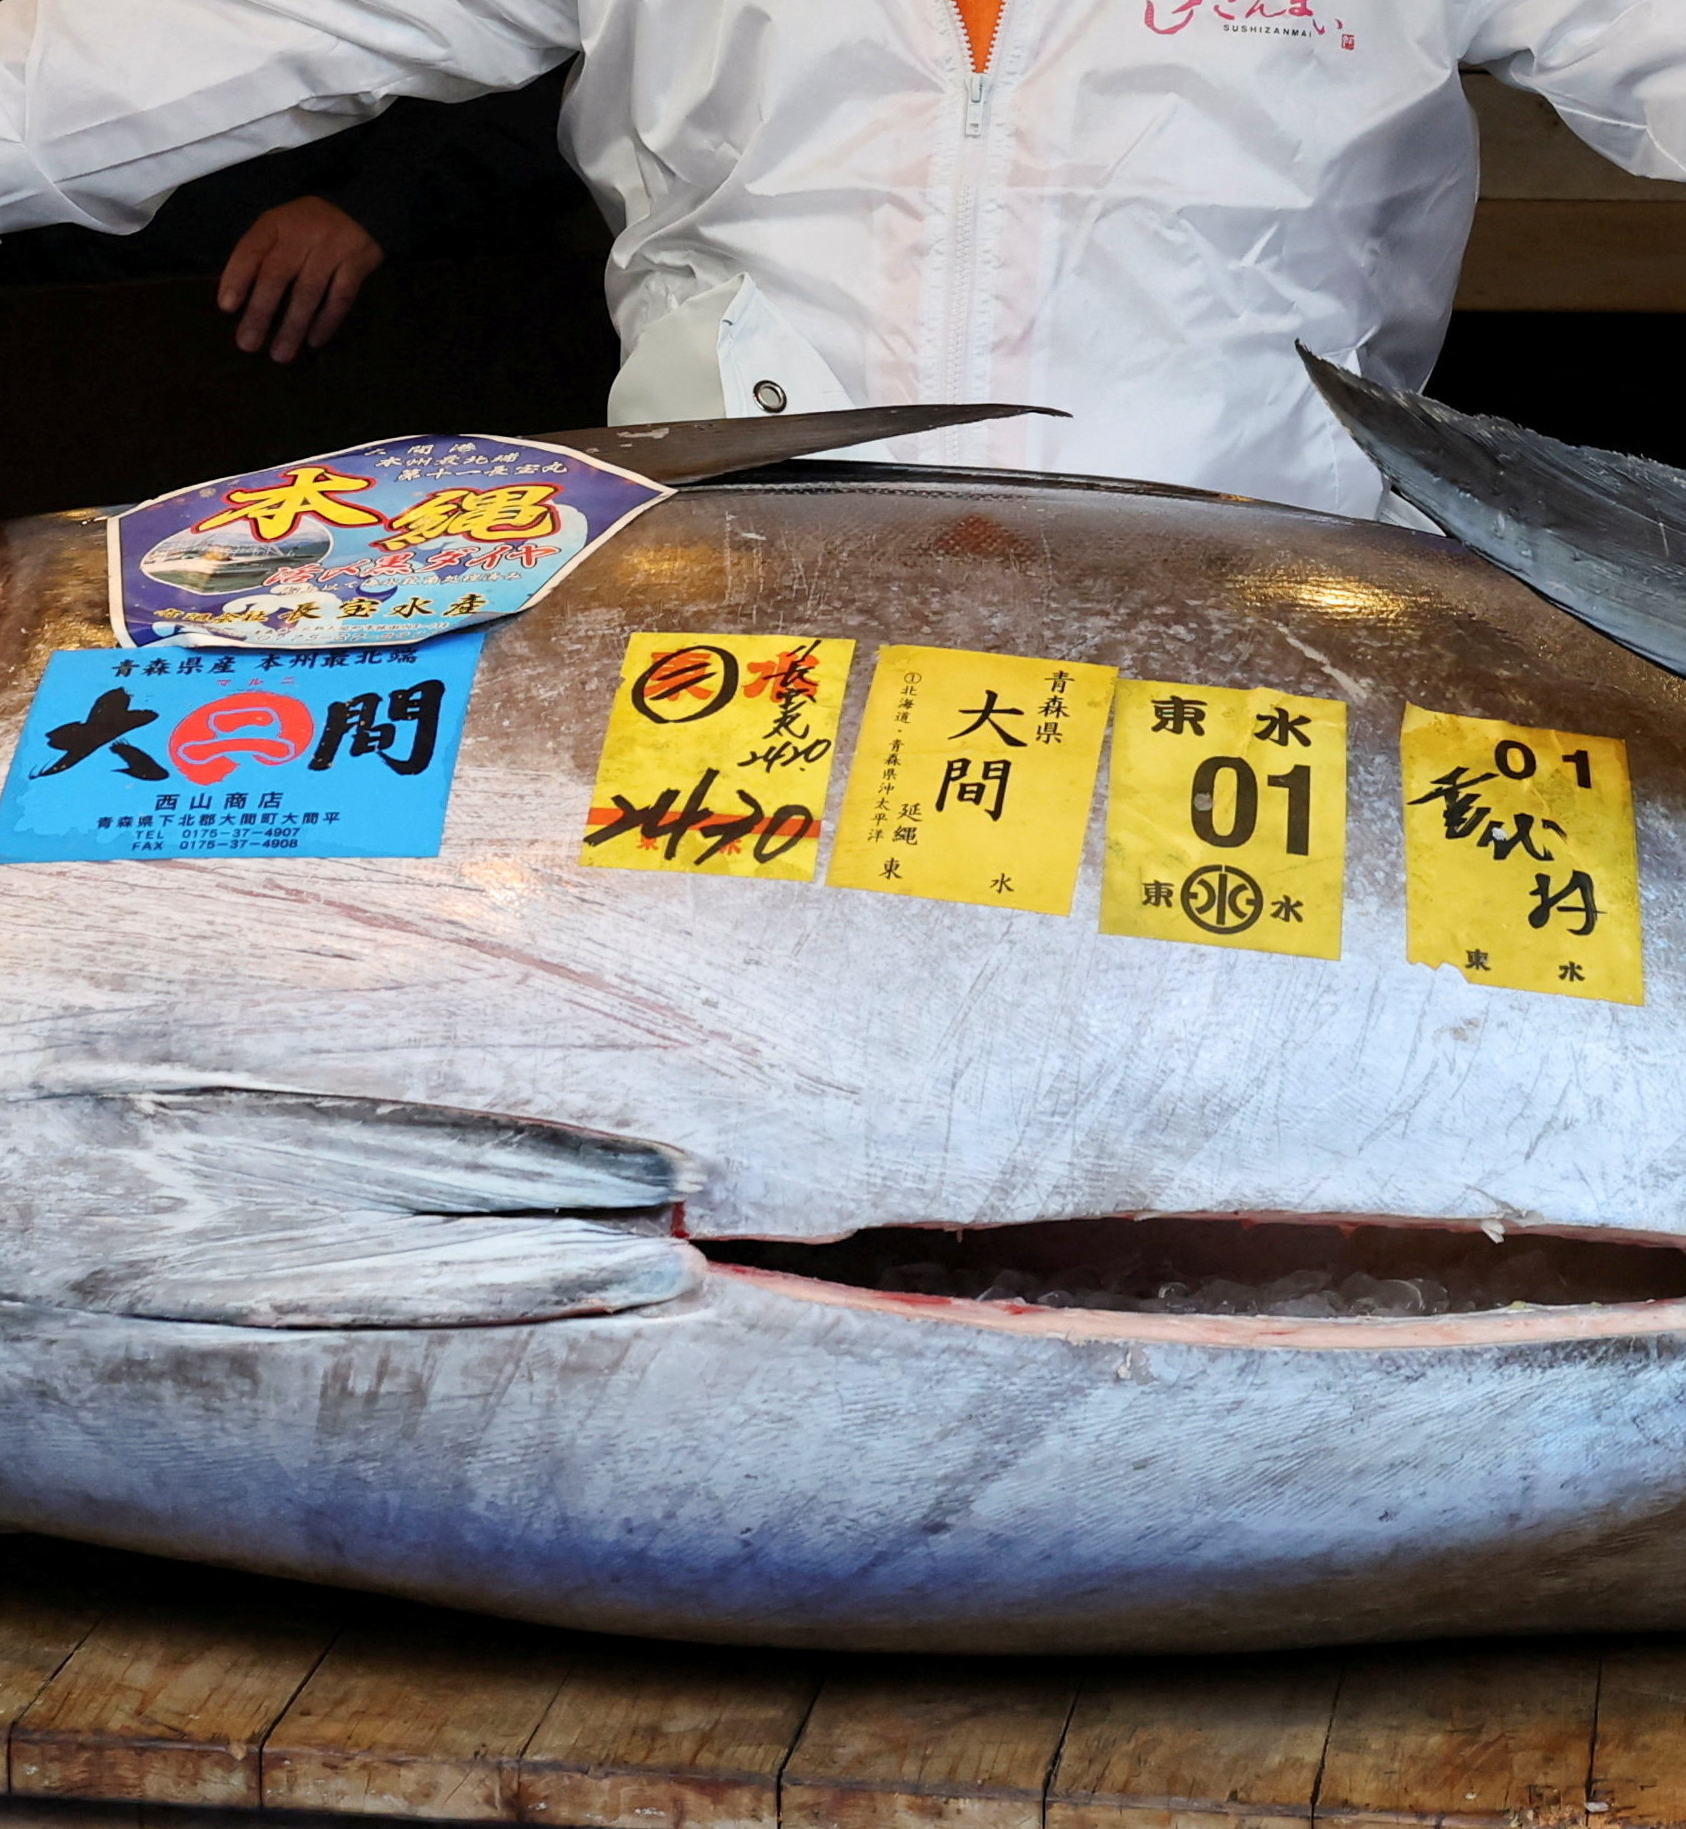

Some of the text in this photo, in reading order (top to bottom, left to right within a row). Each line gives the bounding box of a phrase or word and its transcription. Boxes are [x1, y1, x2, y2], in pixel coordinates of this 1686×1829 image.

[1223, 24, 1313, 38] SUSHIZANMAI
[279, 593, 487, 623] 長宝水産
[112, 648, 419, 676] 青森県産 本州最北端
[1035, 670, 1075, 745] 青森県
[934, 689, 1028, 823] 大間
[1494, 739, 1593, 789] 01
[155, 792, 284, 811] 西山商店
[1190, 756, 1312, 857] 01
[96, 812, 341, 828] 青森県下北郡大間町大間平
[135, 830, 165, 839] TEL
[132, 841, 164, 851] FAX
[878, 857, 1015, 894] 東 水
[1465, 948, 1586, 982] 東 水
